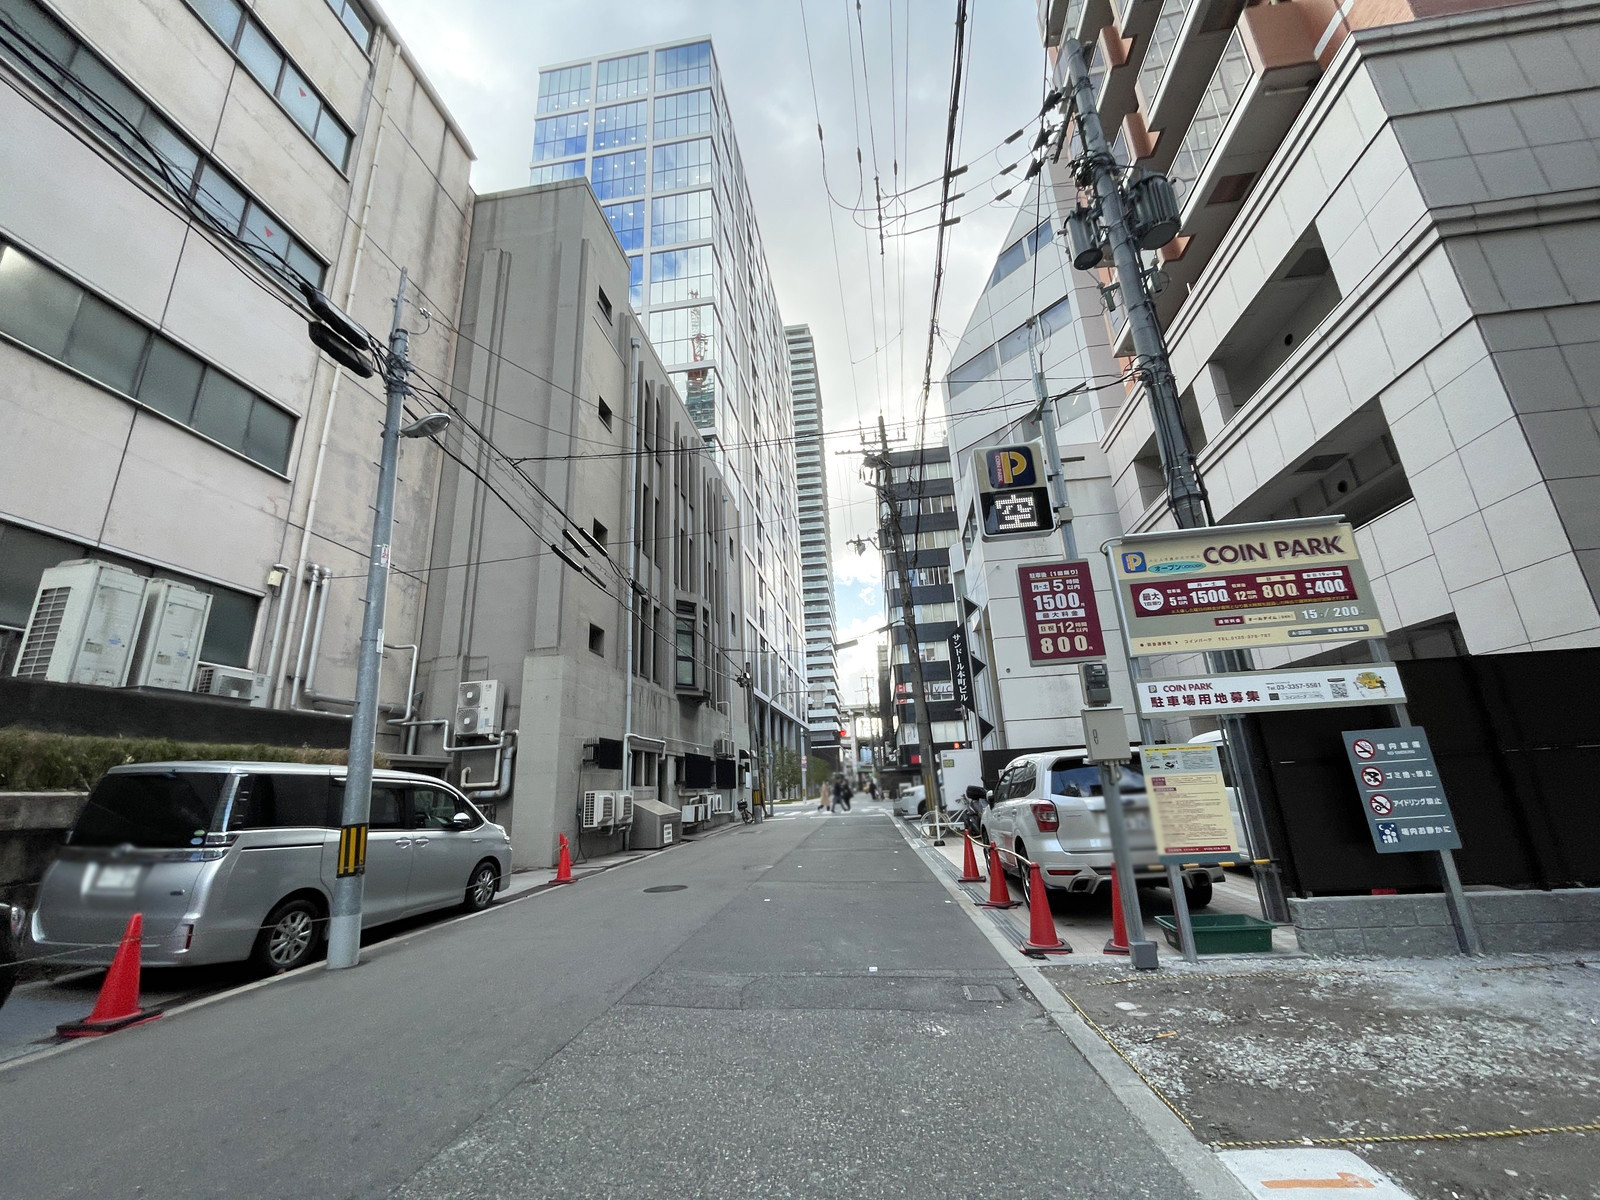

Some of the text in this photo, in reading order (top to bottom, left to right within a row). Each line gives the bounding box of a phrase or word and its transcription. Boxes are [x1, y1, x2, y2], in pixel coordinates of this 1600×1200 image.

[995, 494, 1039, 530] 空
[1203, 536, 1345, 564] COIN PARK
[1053, 579, 1064, 591] 5
[1142, 592, 1161, 601] 最大
[1168, 596, 1177, 606] 5
[1234, 591, 1247, 601] 12
[1042, 610, 1079, 619] 最大料金
[1057, 621, 1075, 633] 12
[952, 633, 968, 702] サンドール本町ビル
[1163, 684, 1187, 693] COIN
[1188, 682, 1213, 691] PARK
[1150, 690, 1260, 708] 駐車場用地募集
[1392, 797, 1442, 807] アイドリング禁止
